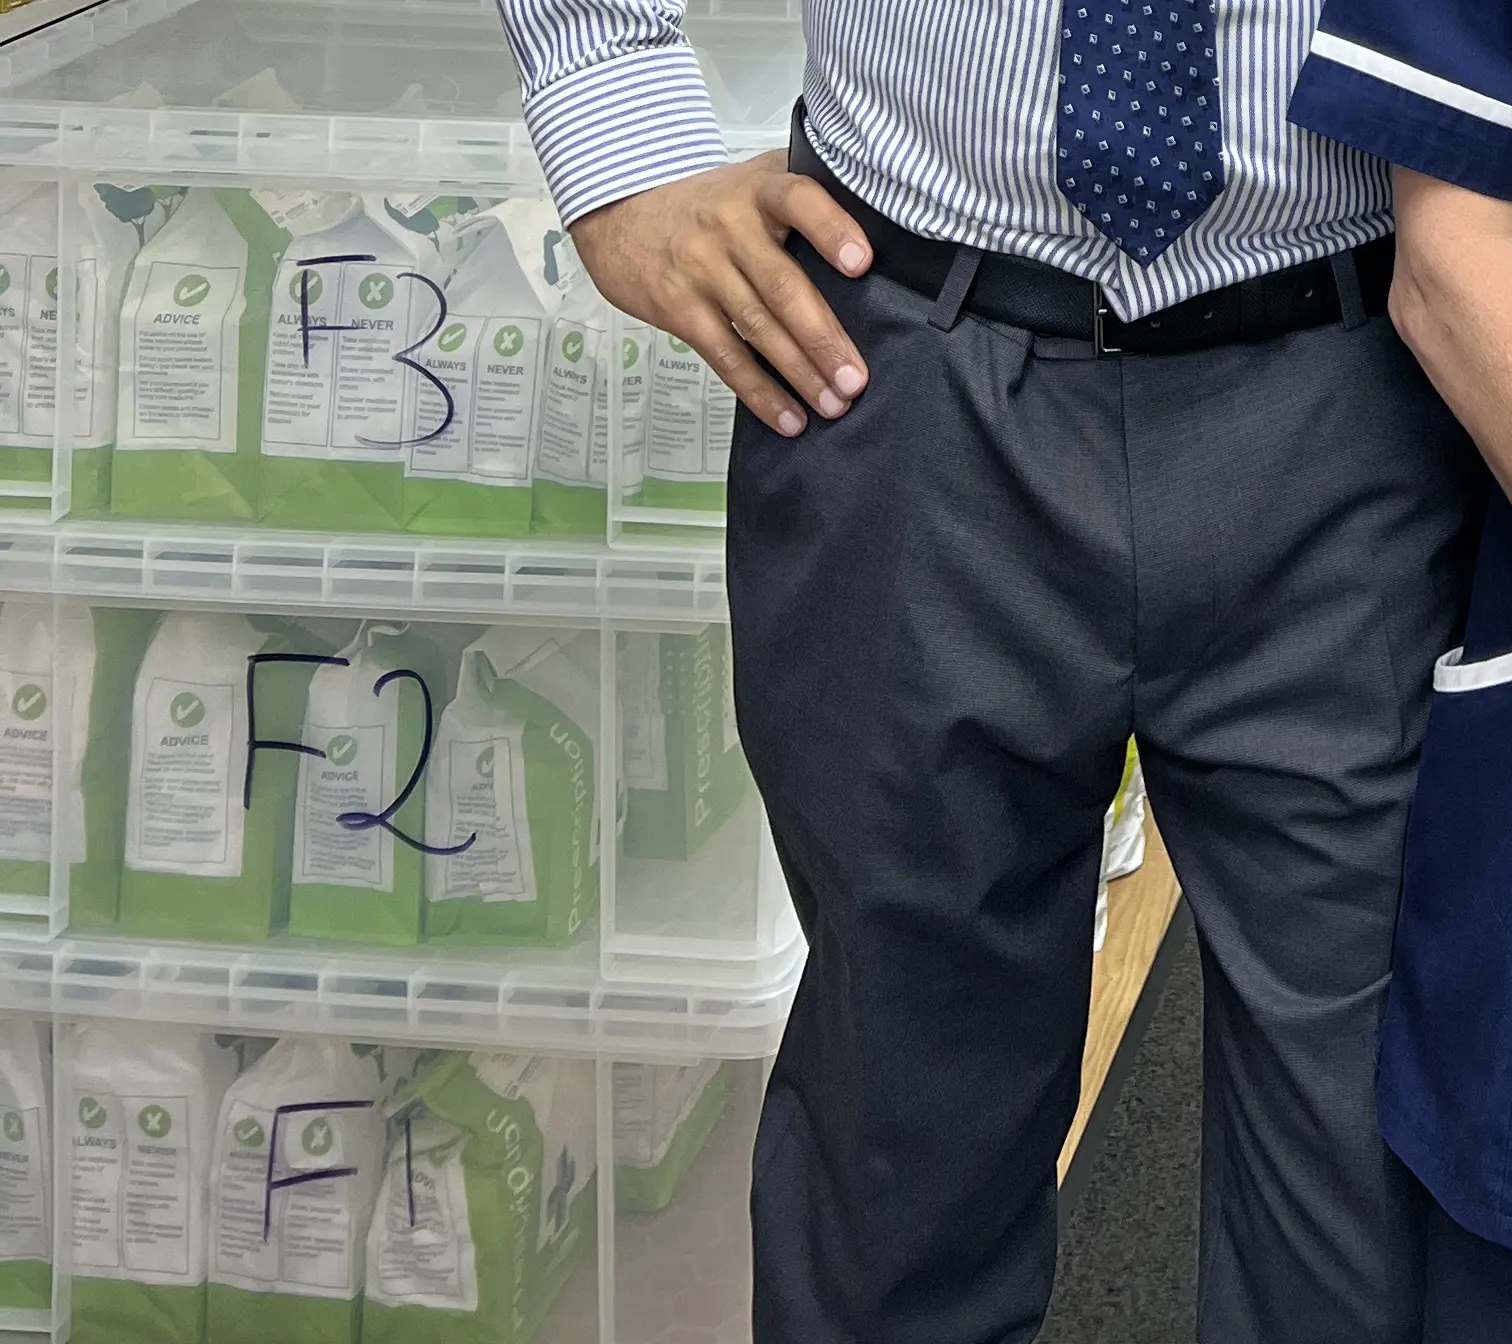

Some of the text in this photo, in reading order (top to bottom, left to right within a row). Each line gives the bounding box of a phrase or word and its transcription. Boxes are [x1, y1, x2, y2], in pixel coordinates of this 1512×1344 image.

[153, 313, 202, 325] ADVICE
[277, 313, 328, 328] ALWAYS
[351, 318, 394, 331] NEVER
[425, 359, 466, 371] ALWAYS
[487, 365, 524, 376] NEVER
[658, 359, 700, 373] ALWAYS
[553, 367, 588, 385] ALWAYS
[3, 728, 48, 741] ADVICE
[160, 734, 209, 747] ADVICE
[244, 652, 477, 855] F2
[321, 771, 359, 781] ADVICE
